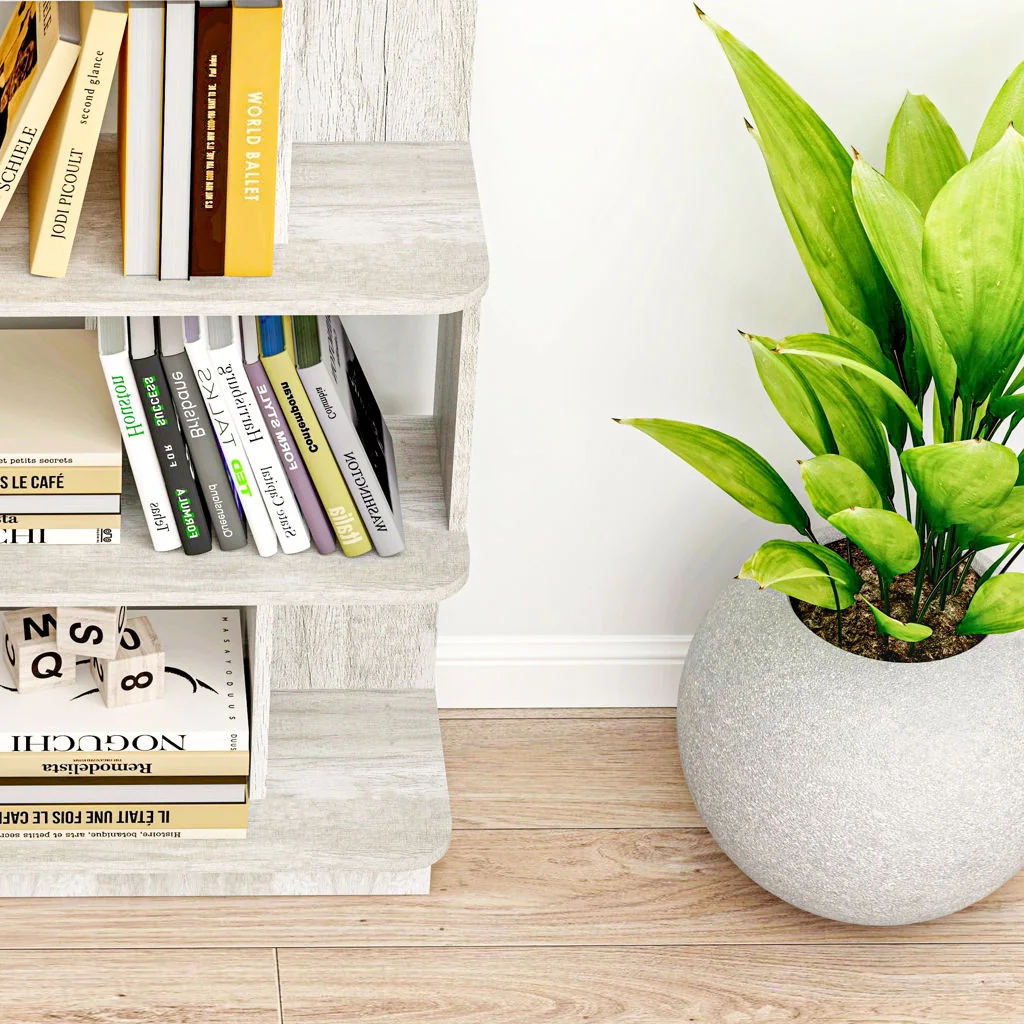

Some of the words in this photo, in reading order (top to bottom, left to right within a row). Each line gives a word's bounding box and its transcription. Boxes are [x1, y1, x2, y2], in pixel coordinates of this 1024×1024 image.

[80, 87, 96, 125] second
[88, 50, 104, 85] glance
[245, 91, 263, 146] WORLD
[59, 147, 84, 207] PICOULT
[243, 151, 260, 202] BALLET
[50, 209, 69, 240] JODI
[10, 456, 36, 466] petits
[39, 457, 73, 465] secrets
[11, 475, 28, 489] LE
[31, 472, 65, 489] CAFÉ
[31, 651, 63, 679] Q
[11, 734, 187, 752] NOGUCHI
[42, 763, 152, 775] Remodelista
[32, 811, 49, 824] LE
[52, 811, 82, 824] FOIS
[86, 811, 113, 825] UNE
[116, 810, 154, 827] ÉTAIT
[157, 810, 170, 824] IL
[23, 831, 51, 840] petits
[87, 830, 137, 839] botanique,
[140, 831, 181, 839] Histoire,
